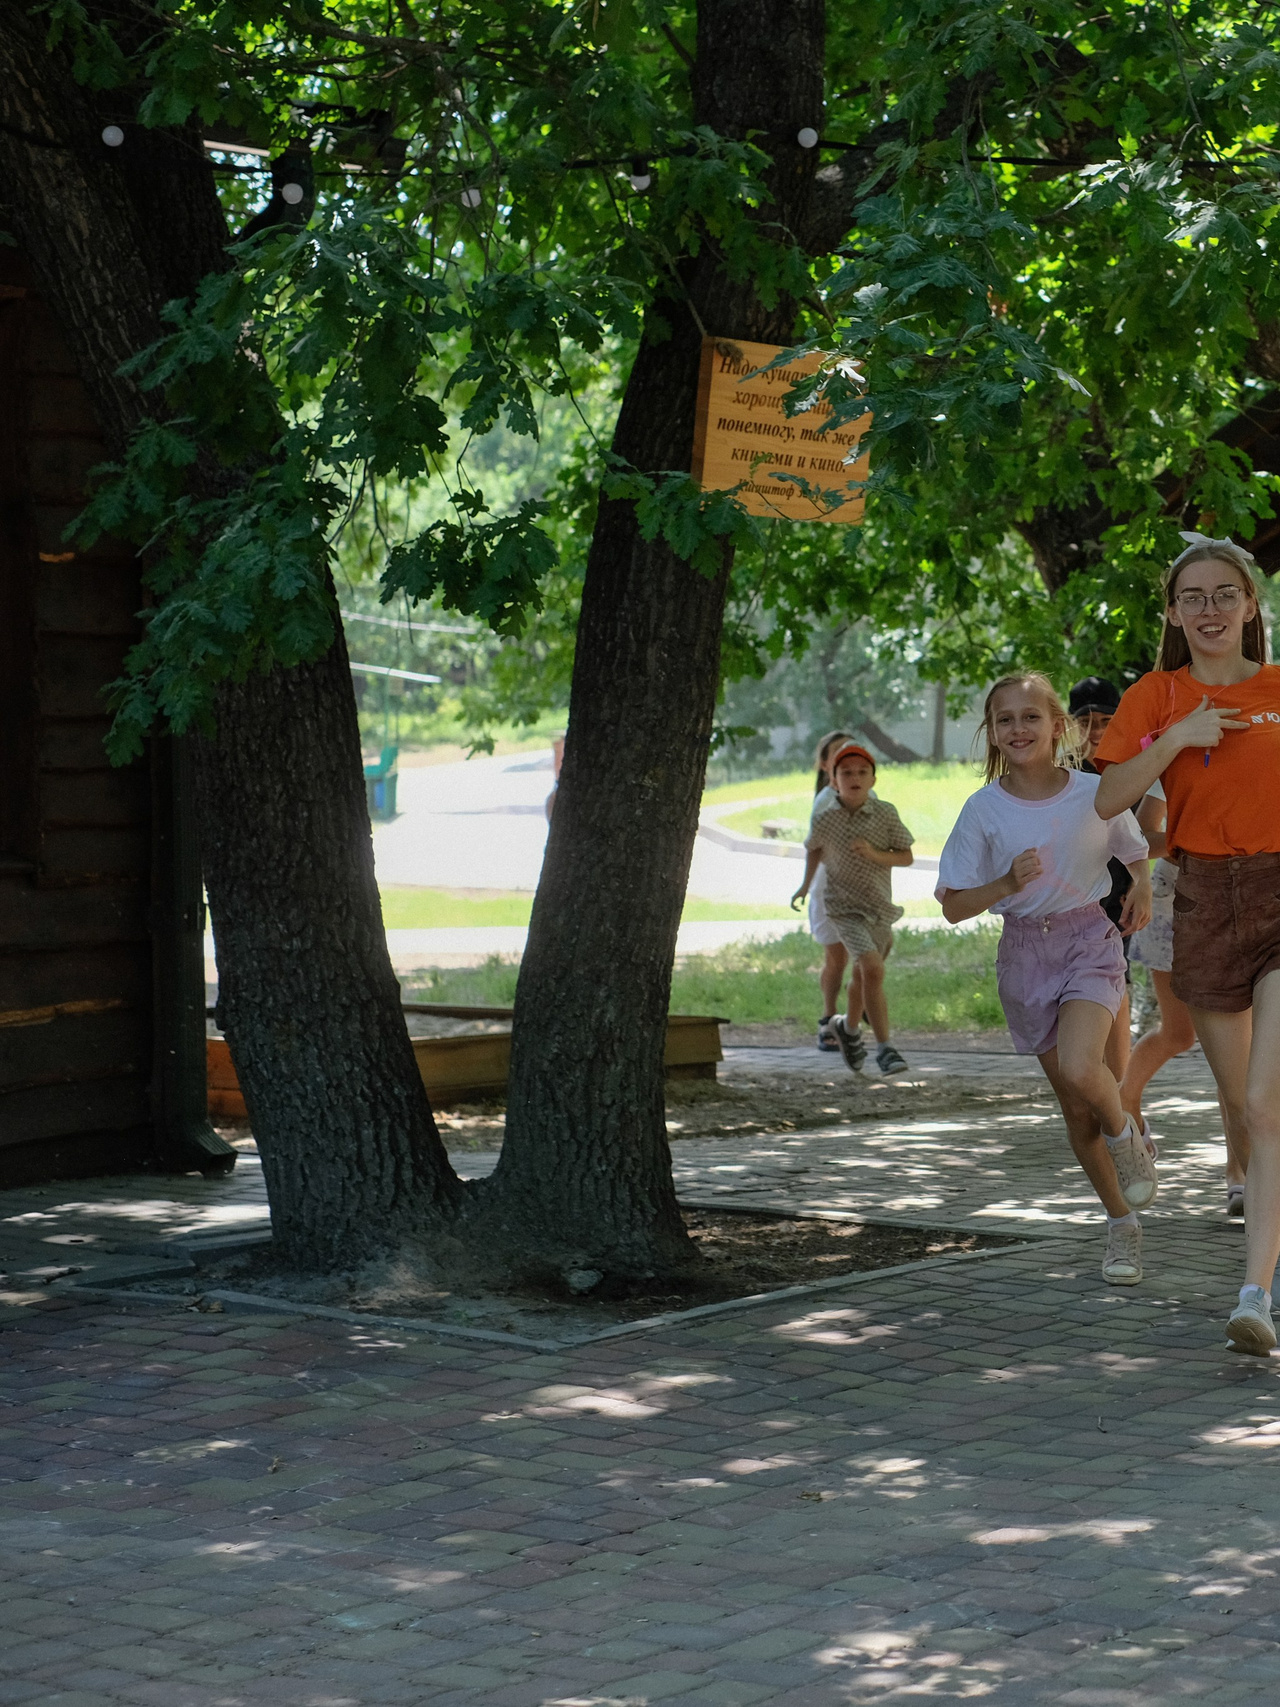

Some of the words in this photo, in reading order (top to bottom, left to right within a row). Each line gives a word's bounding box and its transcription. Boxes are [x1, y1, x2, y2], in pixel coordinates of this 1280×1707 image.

[717, 417, 796, 444] понемногу,
[800, 426, 830, 443] так
[831, 431, 856, 447] же
[796, 454, 806, 468] и
[809, 456, 846, 474] кино.
